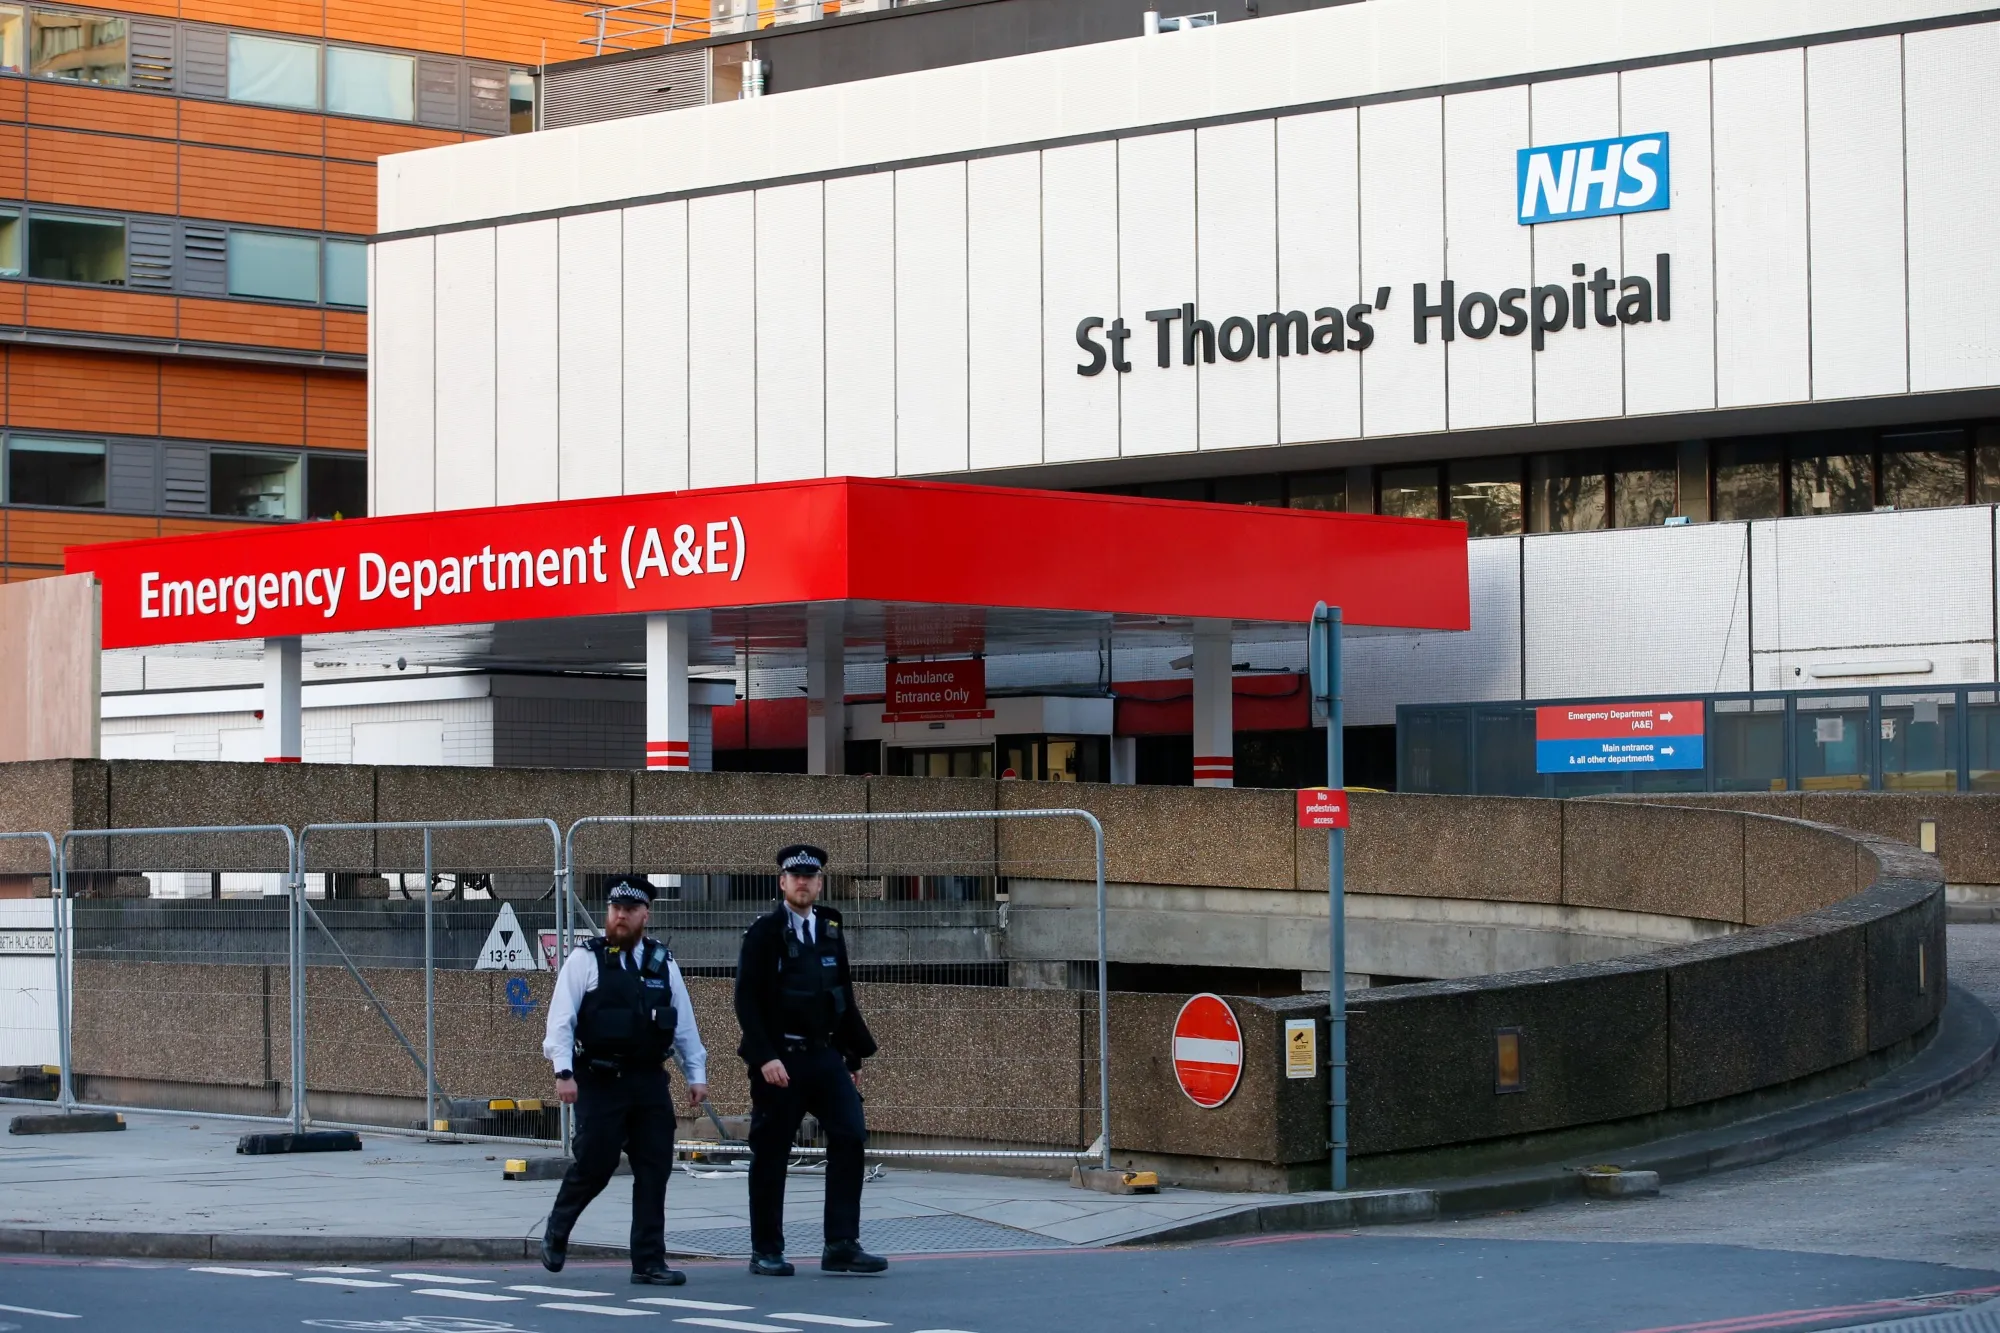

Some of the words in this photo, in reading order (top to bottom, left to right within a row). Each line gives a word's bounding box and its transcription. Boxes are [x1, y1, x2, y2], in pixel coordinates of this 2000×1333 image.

[1520, 138, 1661, 218] NHS
[1076, 316, 1132, 377] St
[1145, 286, 1391, 369] Thomas'
[1413, 253, 1671, 352] Hospital
[140, 565, 346, 625] Emergency
[358, 535, 608, 610] Department
[620, 516, 747, 589] (A&E)
[895, 671, 954, 684] Ambulance
[895, 691, 942, 704] Entrance
[944, 688, 970, 704] Only
[1568, 711, 1609, 721] Emergency
[1610, 709, 1653, 720] Department
[1631, 720, 1653, 730] (A&E)
[1602, 744, 1620, 753] Main
[1621, 743, 1654, 752] entrance
[1569, 756, 1576, 764] &
[1577, 755, 1586, 764] all
[1587, 755, 1607, 763] other
[1608, 754, 1654, 763] departments
[1317, 792, 1327, 800] No
[1306, 803, 1340, 814] pedestrian
[15, 935, 35, 949] PALACE
[37, 935, 54, 949] ROAD
